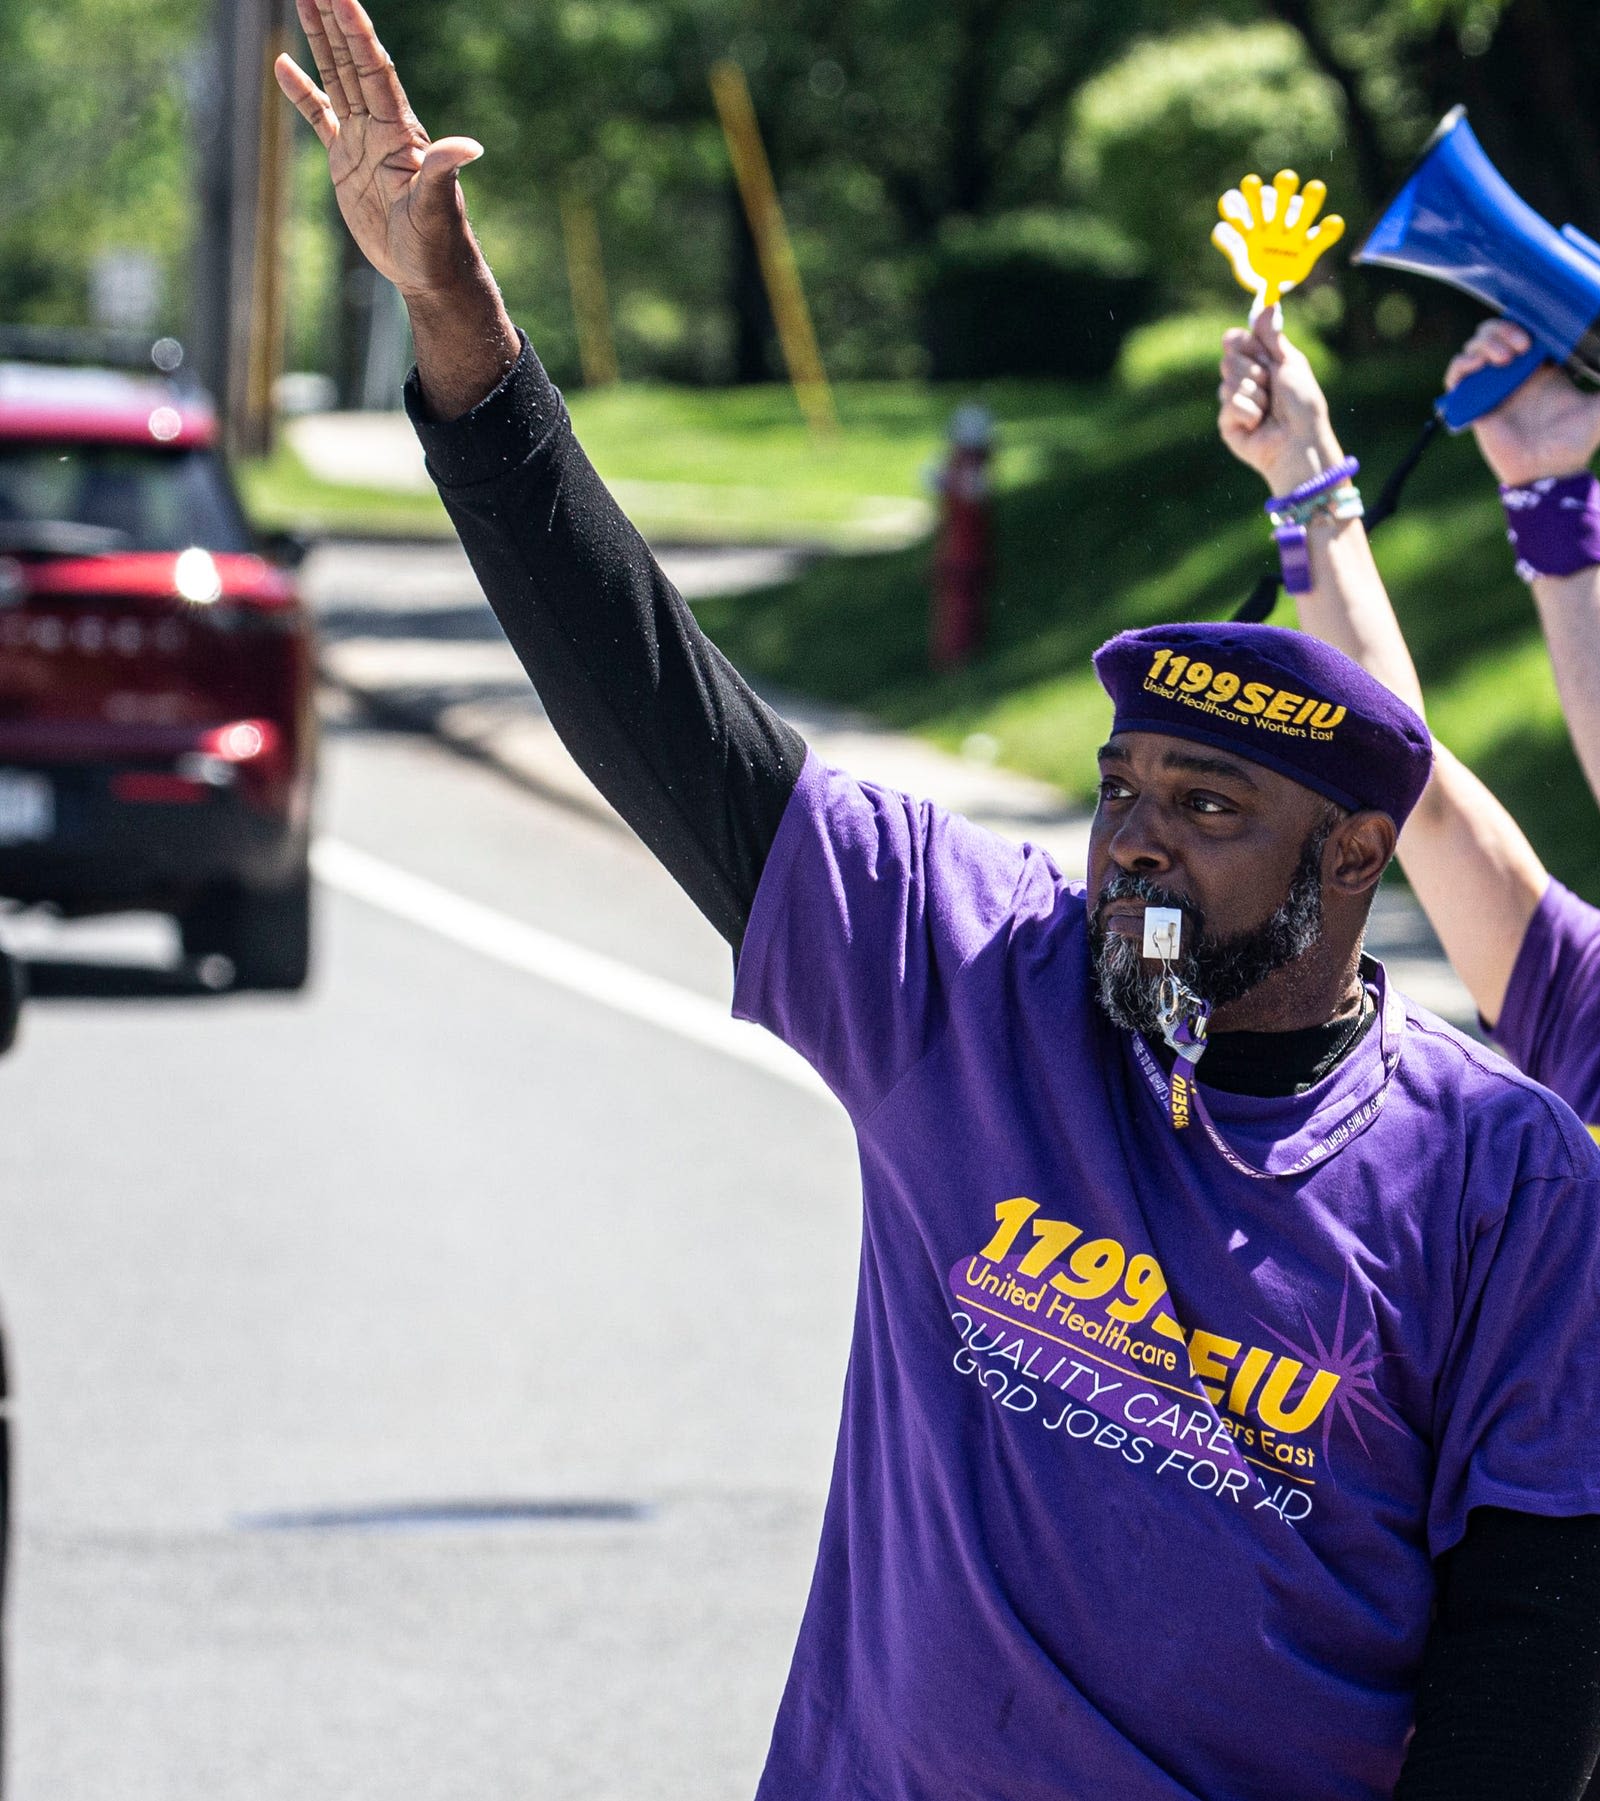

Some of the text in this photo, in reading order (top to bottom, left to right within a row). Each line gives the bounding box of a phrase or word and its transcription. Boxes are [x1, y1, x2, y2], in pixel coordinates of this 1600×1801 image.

[1143, 677, 1334, 742] United Healthcare Workers East
[1147, 648, 1347, 729] 1199SEIU
[1171, 1073, 1189, 1129] 99SEIU
[1346, 1110, 1365, 1133] THIS
[965, 1256, 1048, 1313] United
[1046, 1294, 1178, 1371] Healthcare
[1260, 1430, 1316, 1468] East
[1043, 1403, 1154, 1464] JOBS
[1156, 1449, 1249, 1503] FOR
[1124, 1392, 1235, 1456] CARE
